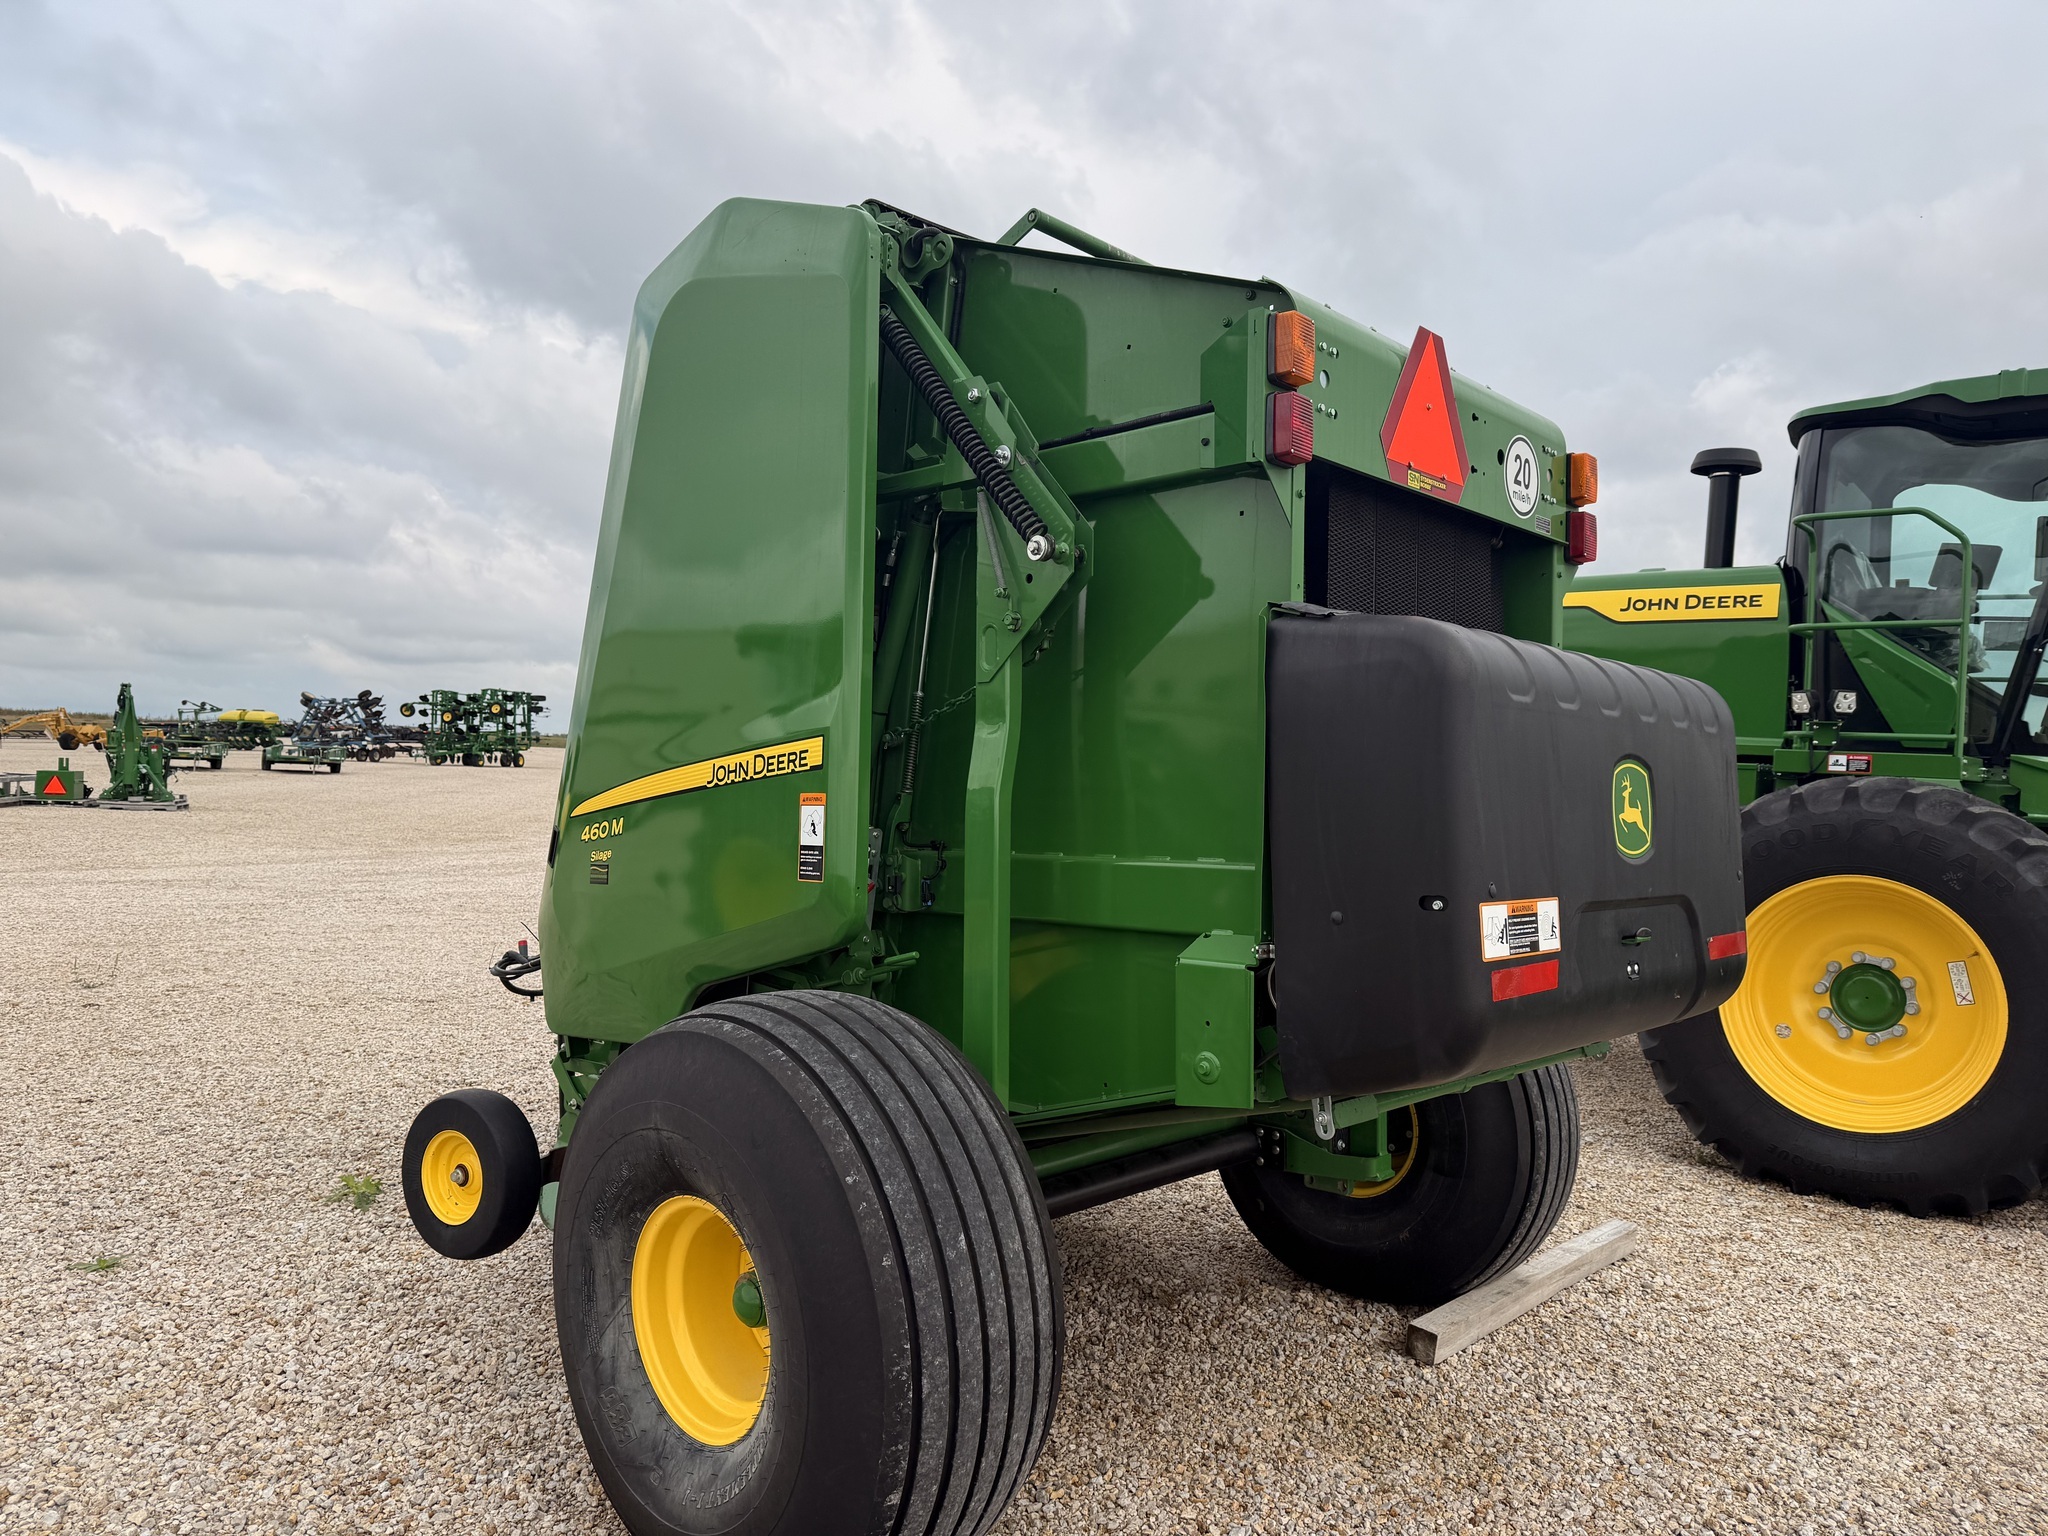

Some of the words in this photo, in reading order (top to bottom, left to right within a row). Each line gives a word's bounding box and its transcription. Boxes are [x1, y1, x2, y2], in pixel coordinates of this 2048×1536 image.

[1513, 453, 1531, 490] 20
[1619, 596, 1679, 612] JOHN
[1685, 594, 1763, 609] DEERE
[707, 760, 749, 785] JOHN
[753, 749, 810, 776] DEERE
[580, 820, 610, 843] 460
[611, 816, 624, 837] M
[590, 849, 612, 862] Silage
[1749, 819, 2018, 900] OODYEAR
